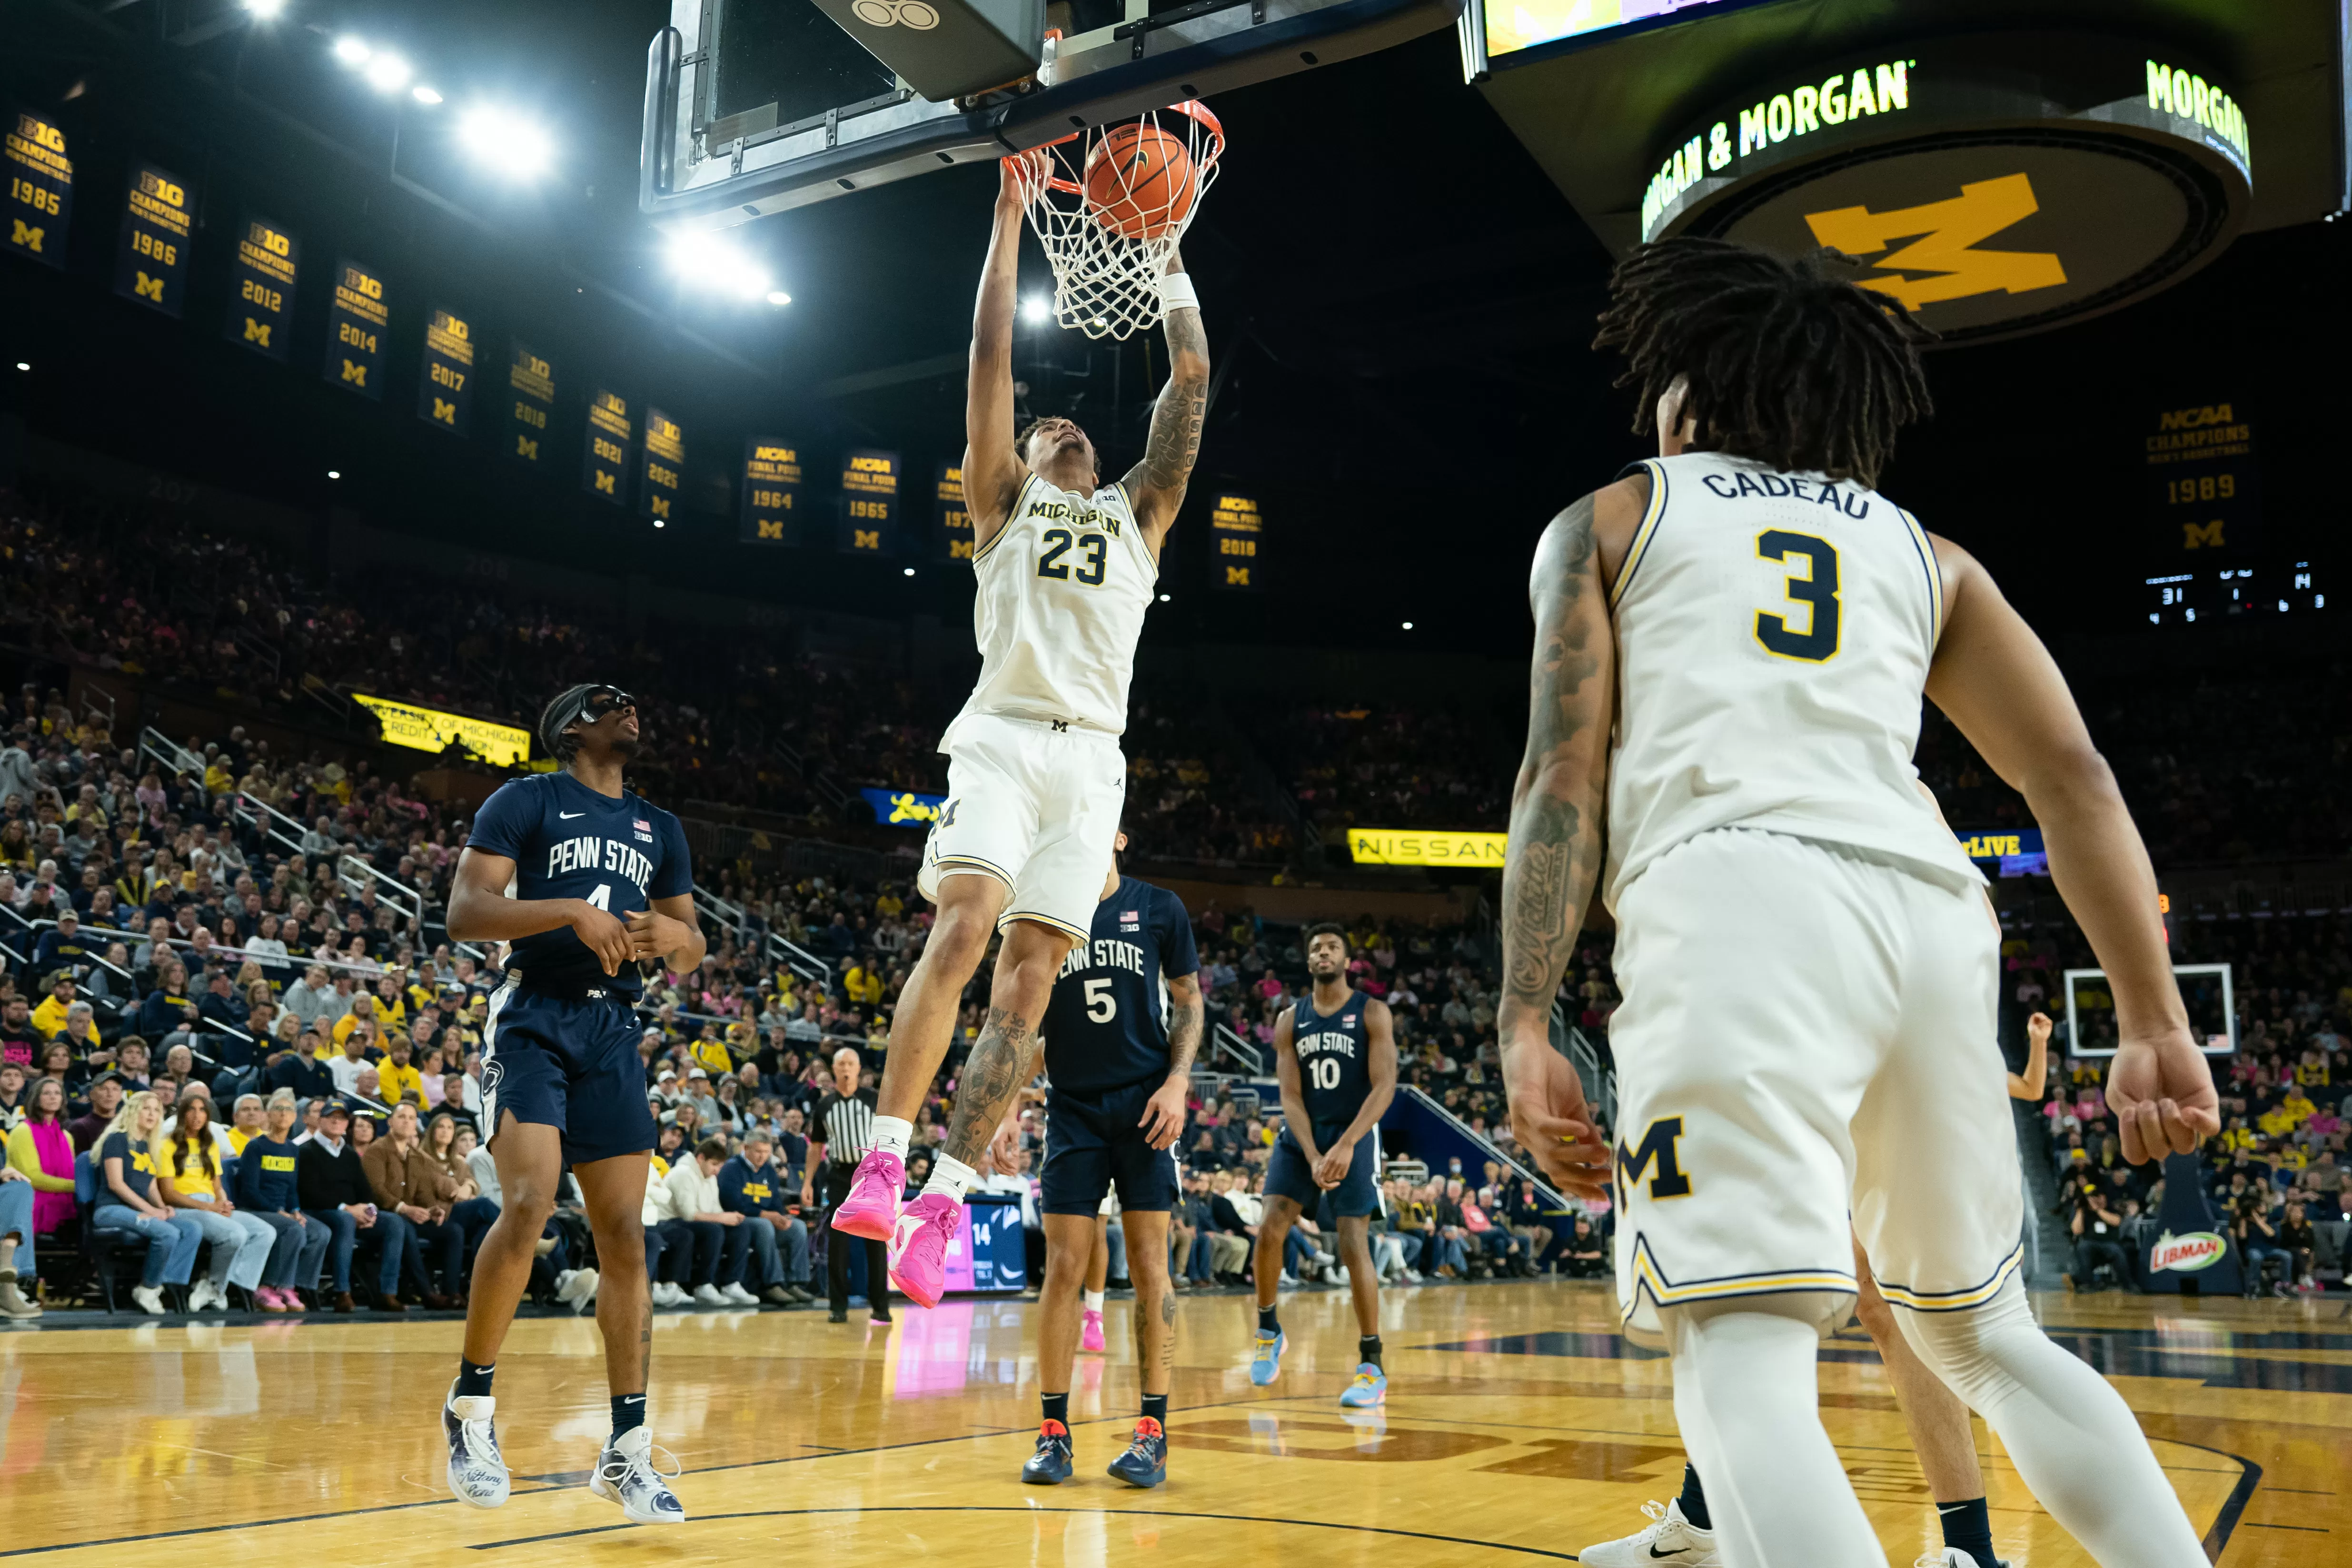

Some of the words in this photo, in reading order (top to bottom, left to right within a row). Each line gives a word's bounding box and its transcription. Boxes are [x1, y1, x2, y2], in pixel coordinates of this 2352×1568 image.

[1708, 122, 1732, 171] &
[1739, 60, 1909, 157] MORGAN
[10, 177, 61, 216] 1985
[11, 218, 45, 253] M
[131, 230, 177, 267] 1986
[1804, 172, 2068, 316] M
[134, 270, 165, 303] M
[242, 279, 282, 313] 2012
[244, 317, 272, 348] M
[339, 322, 377, 354] 2014
[341, 359, 367, 387] M
[431, 362, 465, 392] 2017
[433, 397, 456, 425] M
[2159, 402, 2233, 431] NCAA
[517, 434, 538, 461] M
[2146, 424, 2250, 452] CHAMPIONS
[754, 446, 796, 463] NCAA
[850, 457, 891, 474] NCAA
[595, 468, 615, 495] M
[1701, 472, 1870, 520] CADEAU
[2167, 473, 2235, 505] 1989
[651, 494, 671, 519] M
[753, 489, 792, 509] 1964
[849, 500, 888, 520] 1965
[757, 519, 784, 540] M
[944, 510, 975, 528] 197
[1026, 501, 1121, 540] MICHIGAN
[2182, 518, 2226, 550] M
[854, 529, 880, 549] M
[950, 539, 974, 559] M
[1037, 527, 1109, 588] 23
[1225, 566, 1250, 586] M
[1752, 526, 1843, 665] 3
[463, 724, 527, 745] MICHIGAN
[1051, 719, 1069, 733] M
[1359, 838, 1506, 859] NISSAN
[547, 836, 601, 879] PENN
[605, 839, 653, 897] STATE
[1059, 943, 1091, 980] ENN
[1094, 939, 1145, 976] STATE
[1083, 978, 1117, 1024] 5
[1296, 1032, 1321, 1061] PENN
[1322, 1032, 1356, 1059] STATE
[1309, 1057, 1341, 1090] 10
[1618, 1114, 1693, 1219] M
[972, 1222, 992, 1246] 14
[2154, 1239, 2219, 1269] LIBMAN
